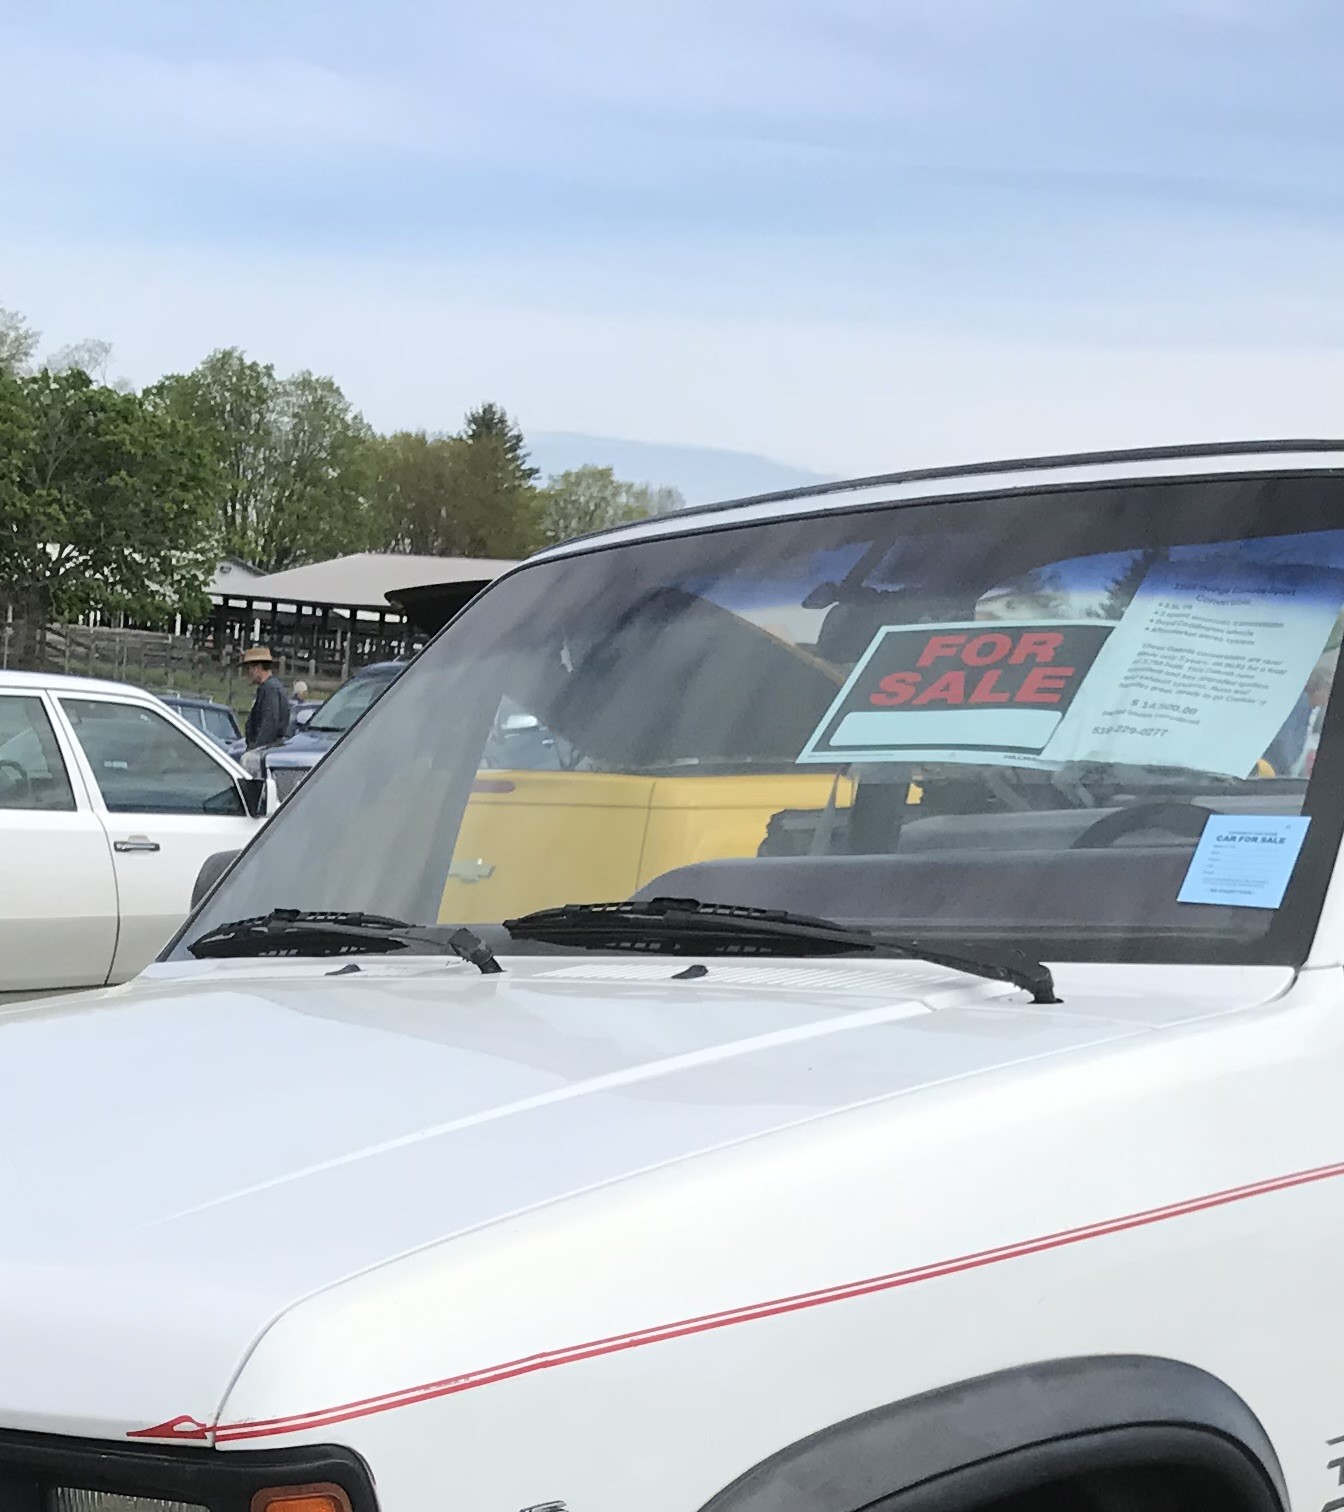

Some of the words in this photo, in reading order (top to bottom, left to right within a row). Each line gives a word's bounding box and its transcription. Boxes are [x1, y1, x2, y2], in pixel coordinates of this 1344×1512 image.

[915, 631, 1065, 668] FOR
[869, 666, 1075, 706] SALE
[1217, 834, 1237, 842] CAR
